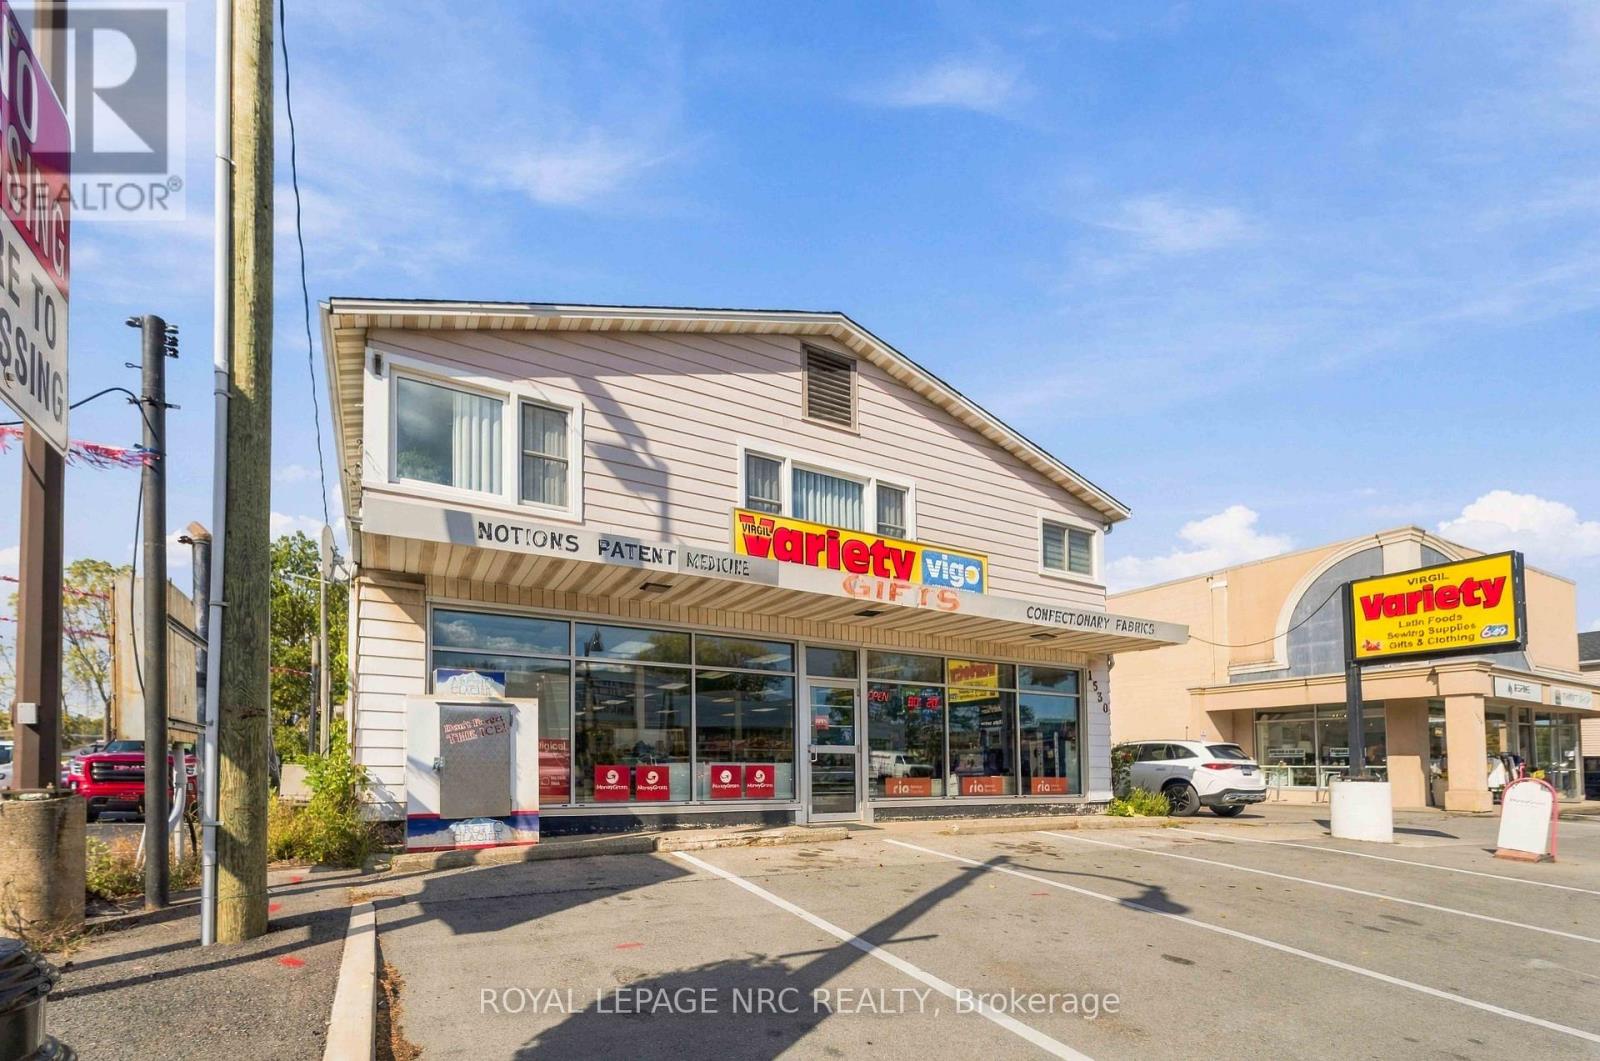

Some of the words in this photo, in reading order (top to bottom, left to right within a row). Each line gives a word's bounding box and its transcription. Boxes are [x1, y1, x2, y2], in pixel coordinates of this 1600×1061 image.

[0, 125, 65, 281] SING
[31, 273, 56, 350] TO
[741, 523, 771, 537] VIRGIL
[478, 521, 580, 553] NOTIONS
[598, 538, 677, 566] PATENT
[686, 551, 750, 577] MEDICINE
[739, 514, 916, 582] Variety
[925, 554, 980, 588] vigo
[1408, 573, 1449, 586] VIRGIL
[842, 575, 960, 612] GIFTS
[1360, 576, 1507, 621] Variety
[1026, 606, 1110, 630] CONFECTONARY
[1116, 619, 1155, 635] FABRICS
[1387, 627, 1425, 640] Sewing
[1428, 622, 1477, 636] Supplies
[1398, 617, 1424, 629] Latin
[1428, 613, 1463, 625] Foods
[1389, 639, 1414, 650] Gifts
[1416, 639, 1424, 647] &
[1428, 633, 1475, 646] Clothing
[868, 690, 889, 702] OPEN
[1087, 670, 1110, 714] 1530
